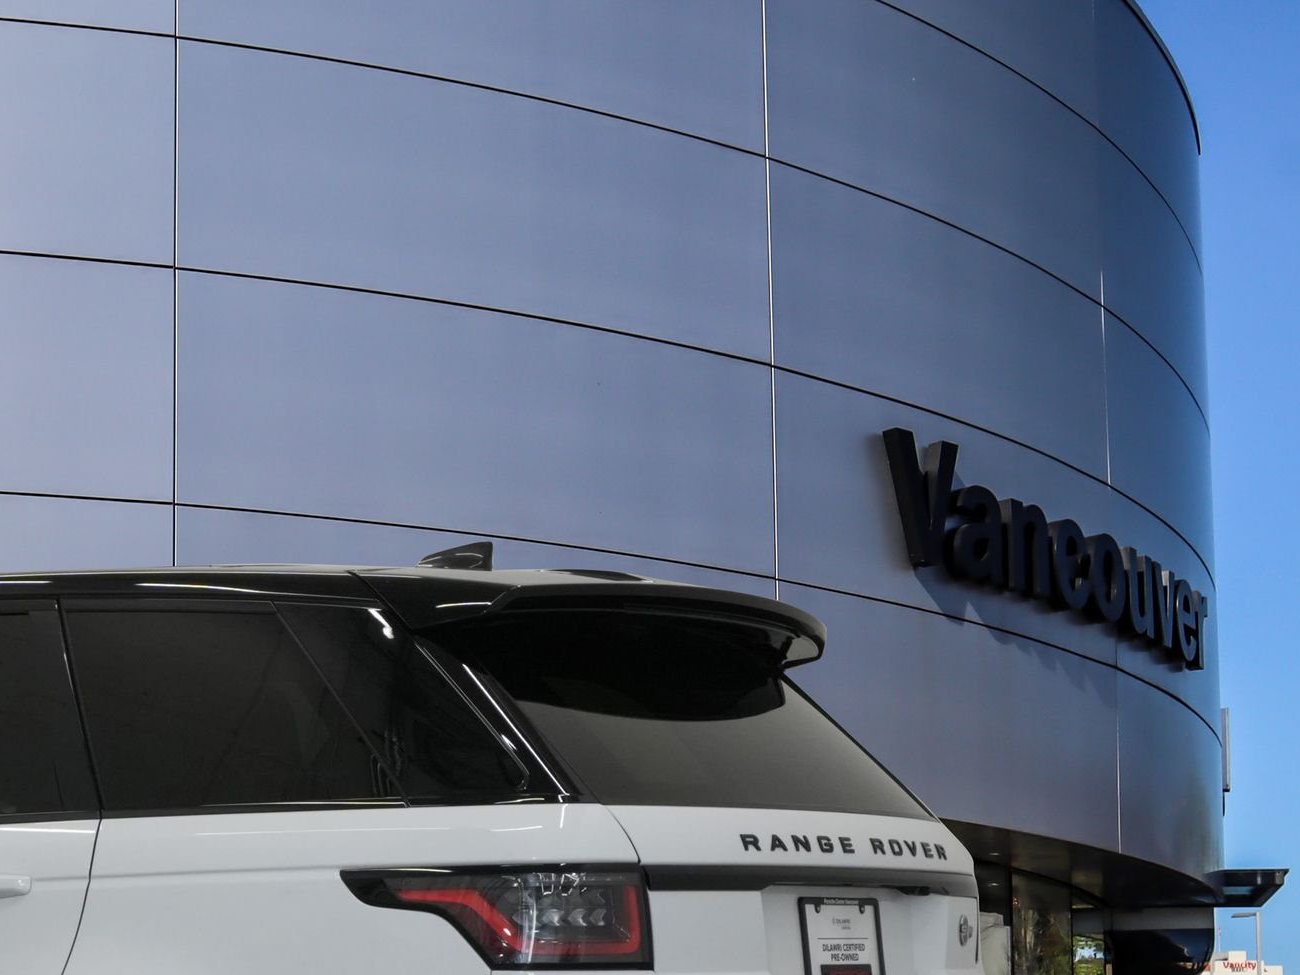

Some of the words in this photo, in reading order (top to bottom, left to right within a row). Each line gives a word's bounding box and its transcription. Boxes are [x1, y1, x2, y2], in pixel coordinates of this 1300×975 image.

[882, 427, 1208, 671] Vancouver
[740, 833, 856, 854] RANGE
[869, 837, 948, 861] ROVER
[822, 943, 842, 952] DILAWRI
[842, 943, 866, 952] CERTIFIED
[830, 952, 860, 962] PRE-OWNED
[1222, 960, 1256, 970] Vancity
